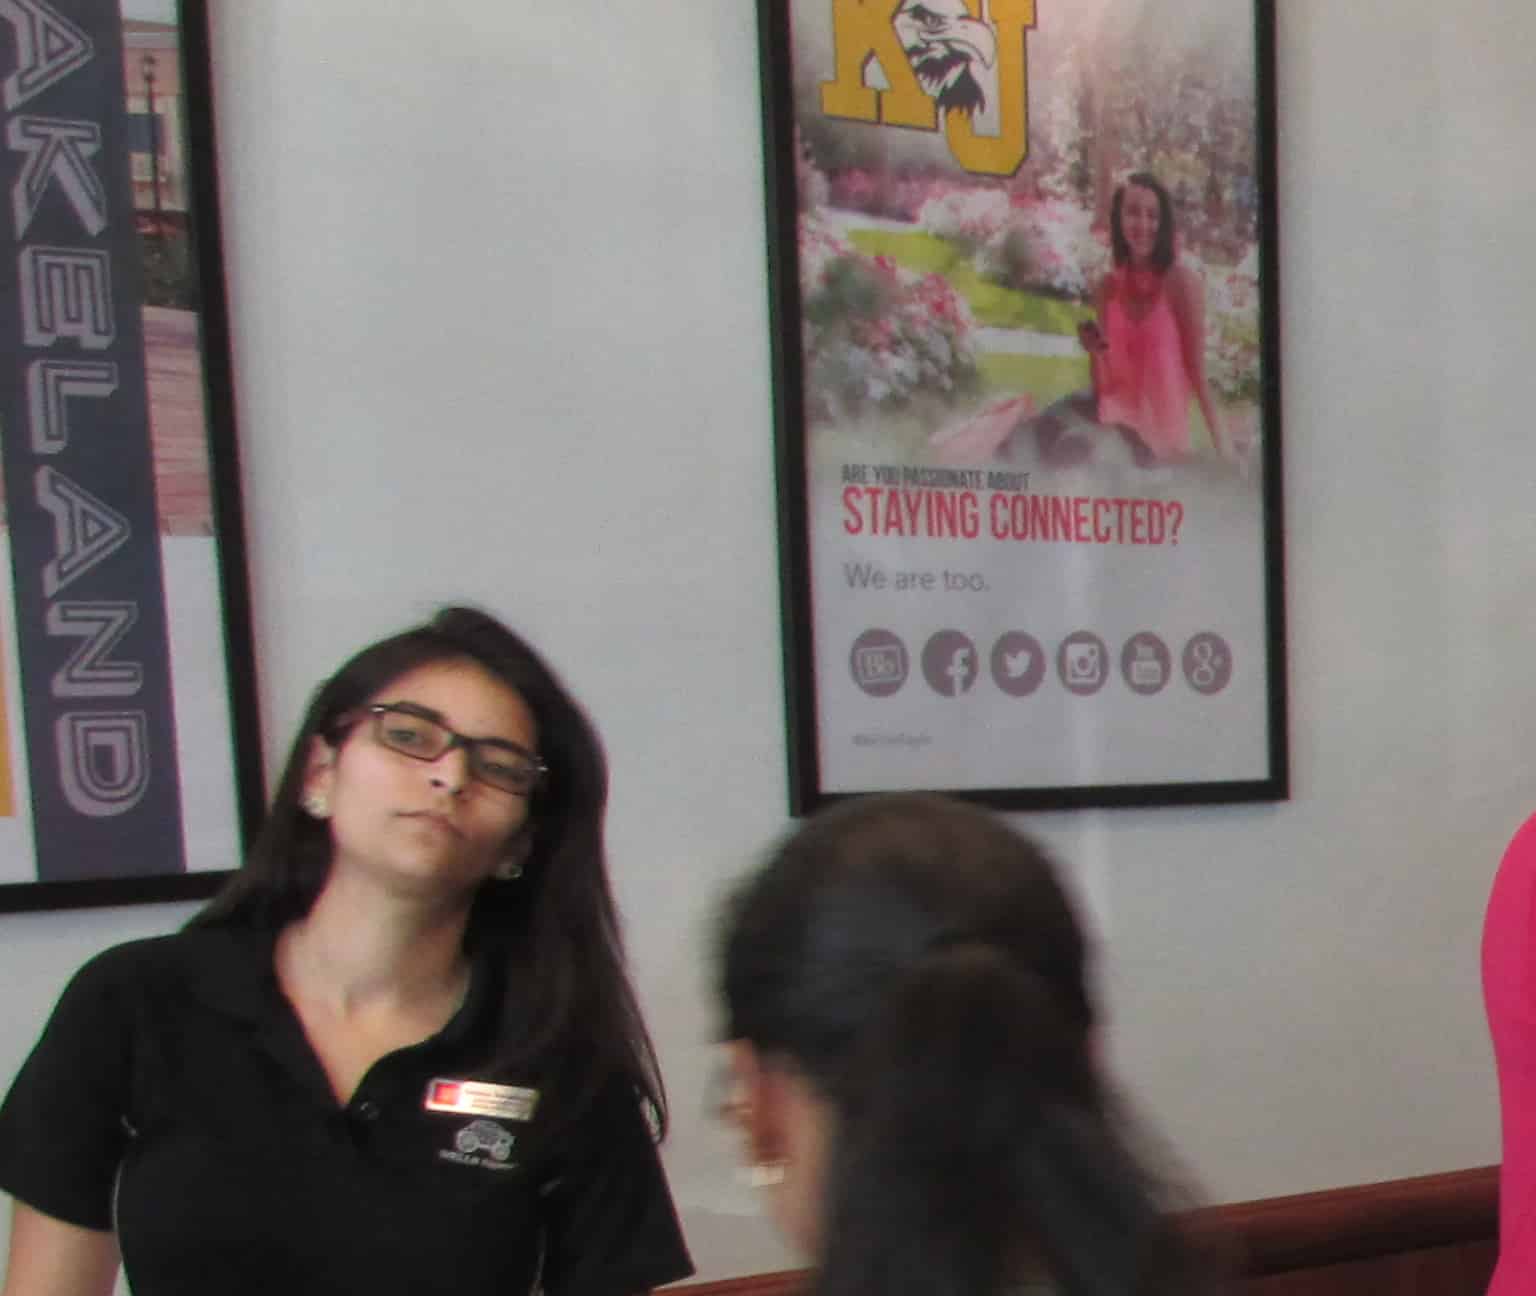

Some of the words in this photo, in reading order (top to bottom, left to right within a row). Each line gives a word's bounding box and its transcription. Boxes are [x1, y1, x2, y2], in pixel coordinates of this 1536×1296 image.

[841, 485, 980, 540] STAYING
[989, 490, 1184, 546] CONNECTED?
[844, 562, 887, 590] We
[894, 569, 936, 592] are
[943, 567, 991, 593] too.
